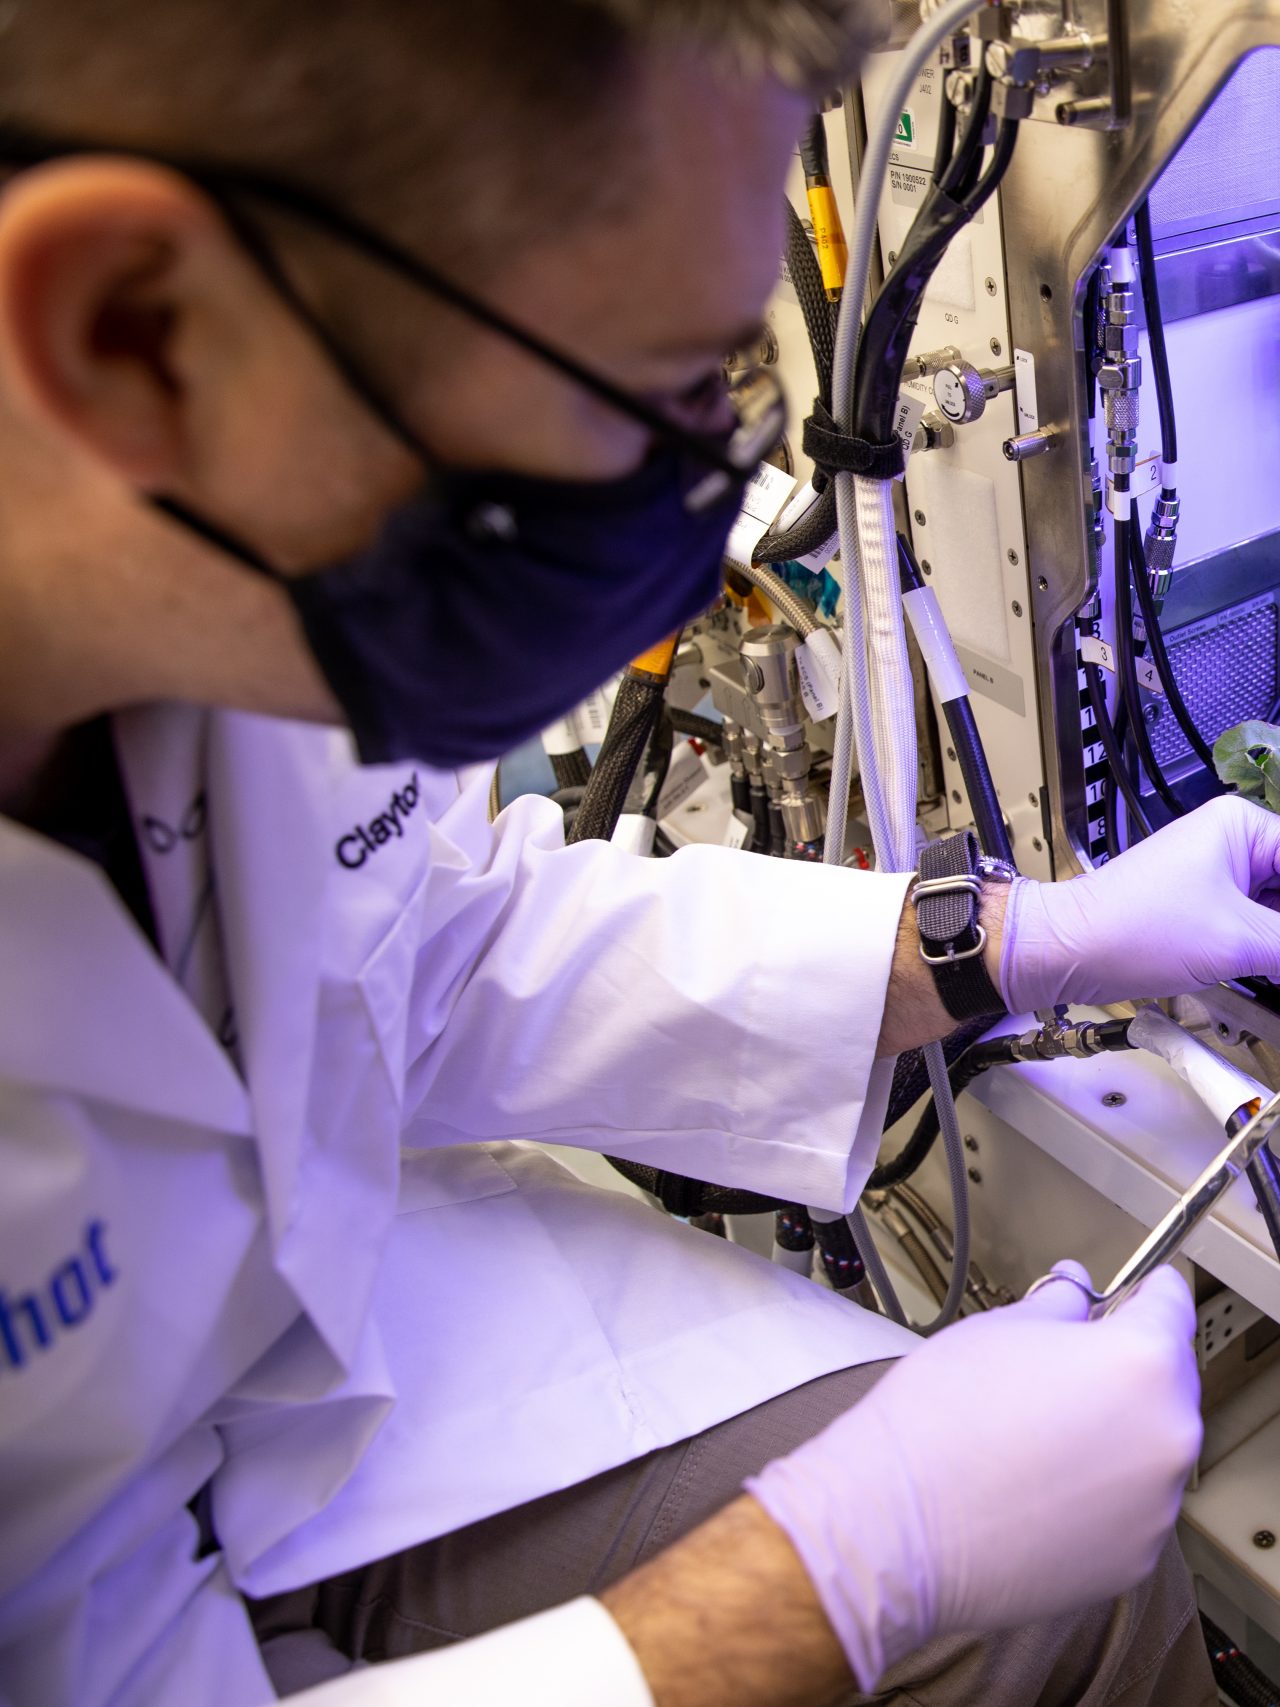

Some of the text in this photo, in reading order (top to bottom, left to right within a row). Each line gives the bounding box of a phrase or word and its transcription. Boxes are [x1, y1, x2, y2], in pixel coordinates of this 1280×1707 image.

[902, 173, 927, 186] 1900522
[902, 182, 917, 193] 0001
[1150, 464, 1157, 481] 2
[1100, 646, 1108, 661] 3
[1144, 669, 1153, 683] 4
[1087, 742, 1108, 763] 12
[0, 1218, 115, 1368] hot
